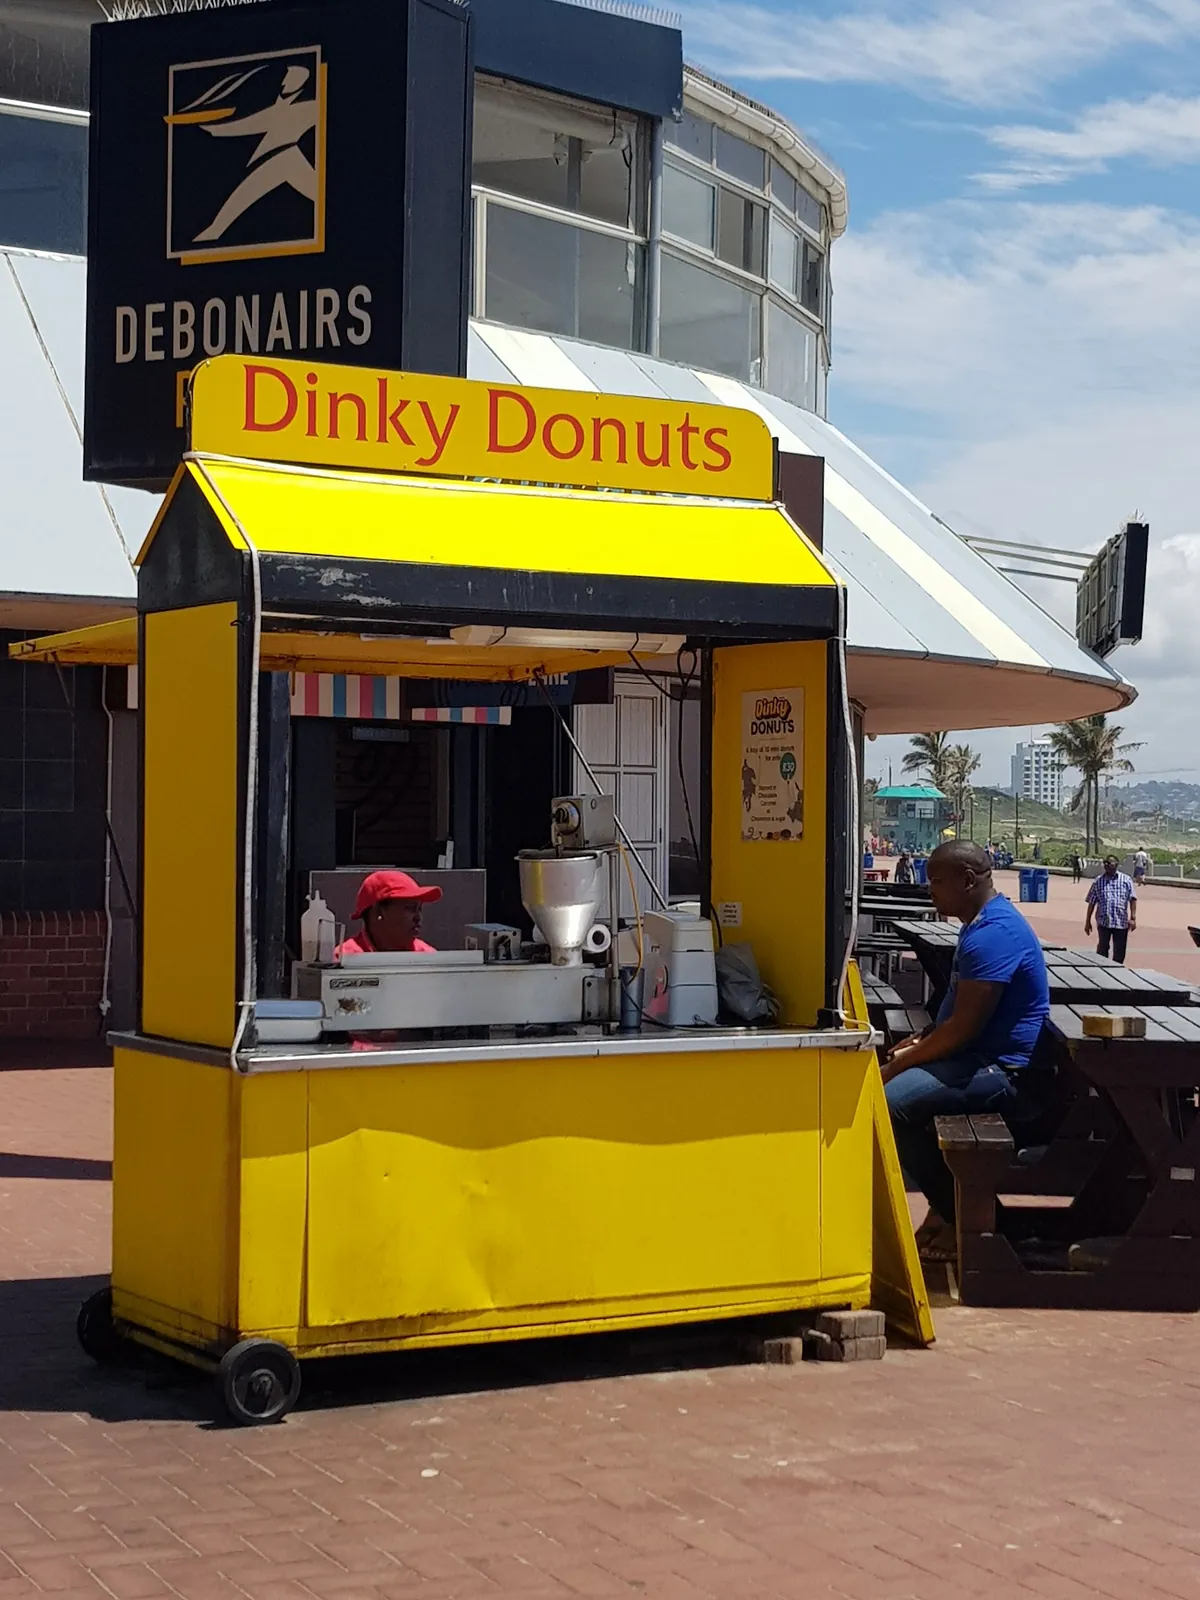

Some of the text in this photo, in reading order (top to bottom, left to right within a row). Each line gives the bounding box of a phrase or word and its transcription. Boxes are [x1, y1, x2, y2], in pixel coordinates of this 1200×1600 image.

[115, 285, 373, 364] DEBONAIRS
[242, 364, 460, 467] Dinky
[487, 388, 732, 472] Donuts
[750, 719, 795, 736] DONUTS
[755, 696, 792, 721] Dinky
